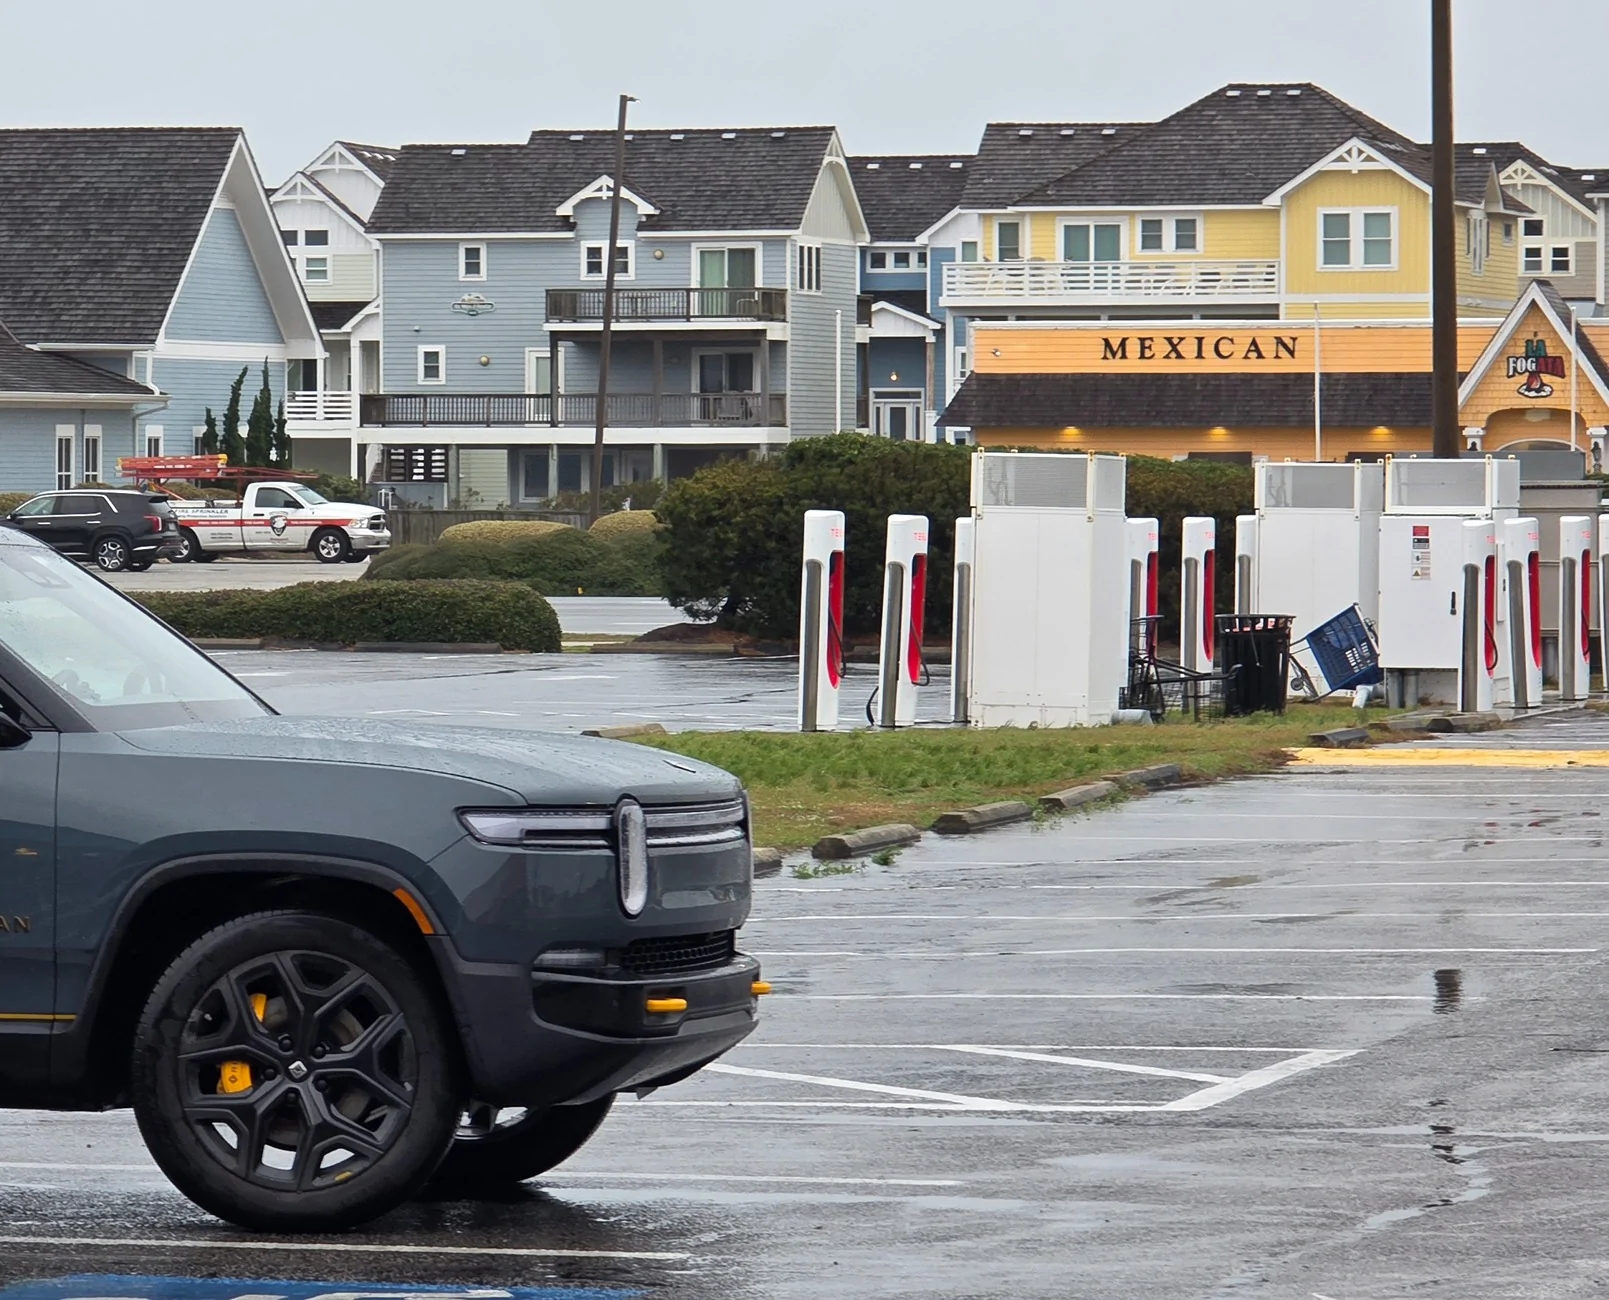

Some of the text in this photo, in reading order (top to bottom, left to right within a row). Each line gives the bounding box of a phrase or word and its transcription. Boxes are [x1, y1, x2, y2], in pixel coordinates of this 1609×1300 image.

[1101, 336, 1298, 360] MEXICAN
[1525, 339, 1547, 355] LA
[1508, 355, 1565, 376] FOGATA
